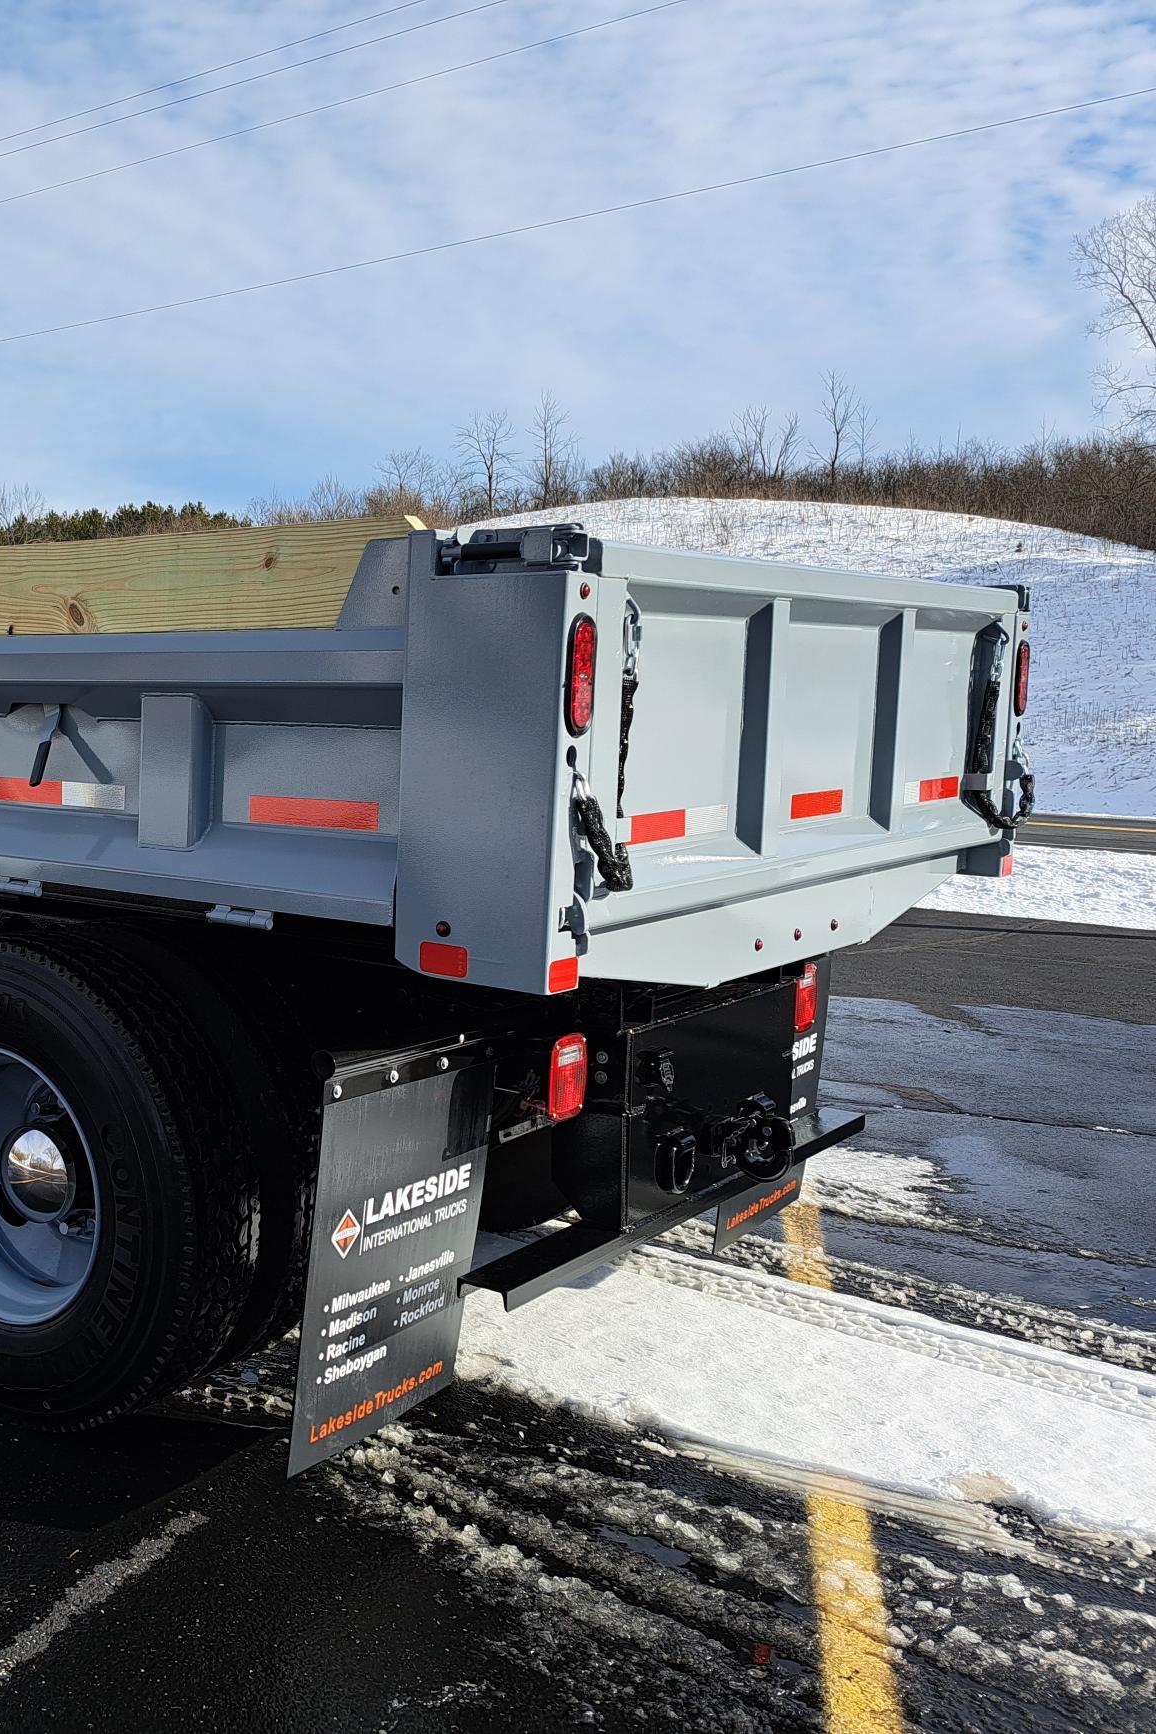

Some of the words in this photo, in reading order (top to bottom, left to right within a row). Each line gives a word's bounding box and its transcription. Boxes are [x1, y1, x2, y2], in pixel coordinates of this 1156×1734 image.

[792, 1033, 818, 1061] SIDE
[797, 1059, 815, 1077] TRUCKS
[365, 1162, 472, 1226] LAKESIDE
[726, 1180, 797, 1231] LakesideTrucks.com
[362, 1212, 433, 1252] INTERNATIONAL
[434, 1198, 468, 1224] TRUCKS
[405, 1250, 455, 1282] Janesville
[331, 1280, 391, 1314] Milwaukee
[402, 1278, 440, 1304] Monroe
[328, 1306, 378, 1338] Madison
[399, 1292, 445, 1328] Rockford
[326, 1333, 366, 1362] Racine
[324, 1345, 388, 1385] Sheboygan
[309, 1360, 444, 1444] LakesideTrucks.com
